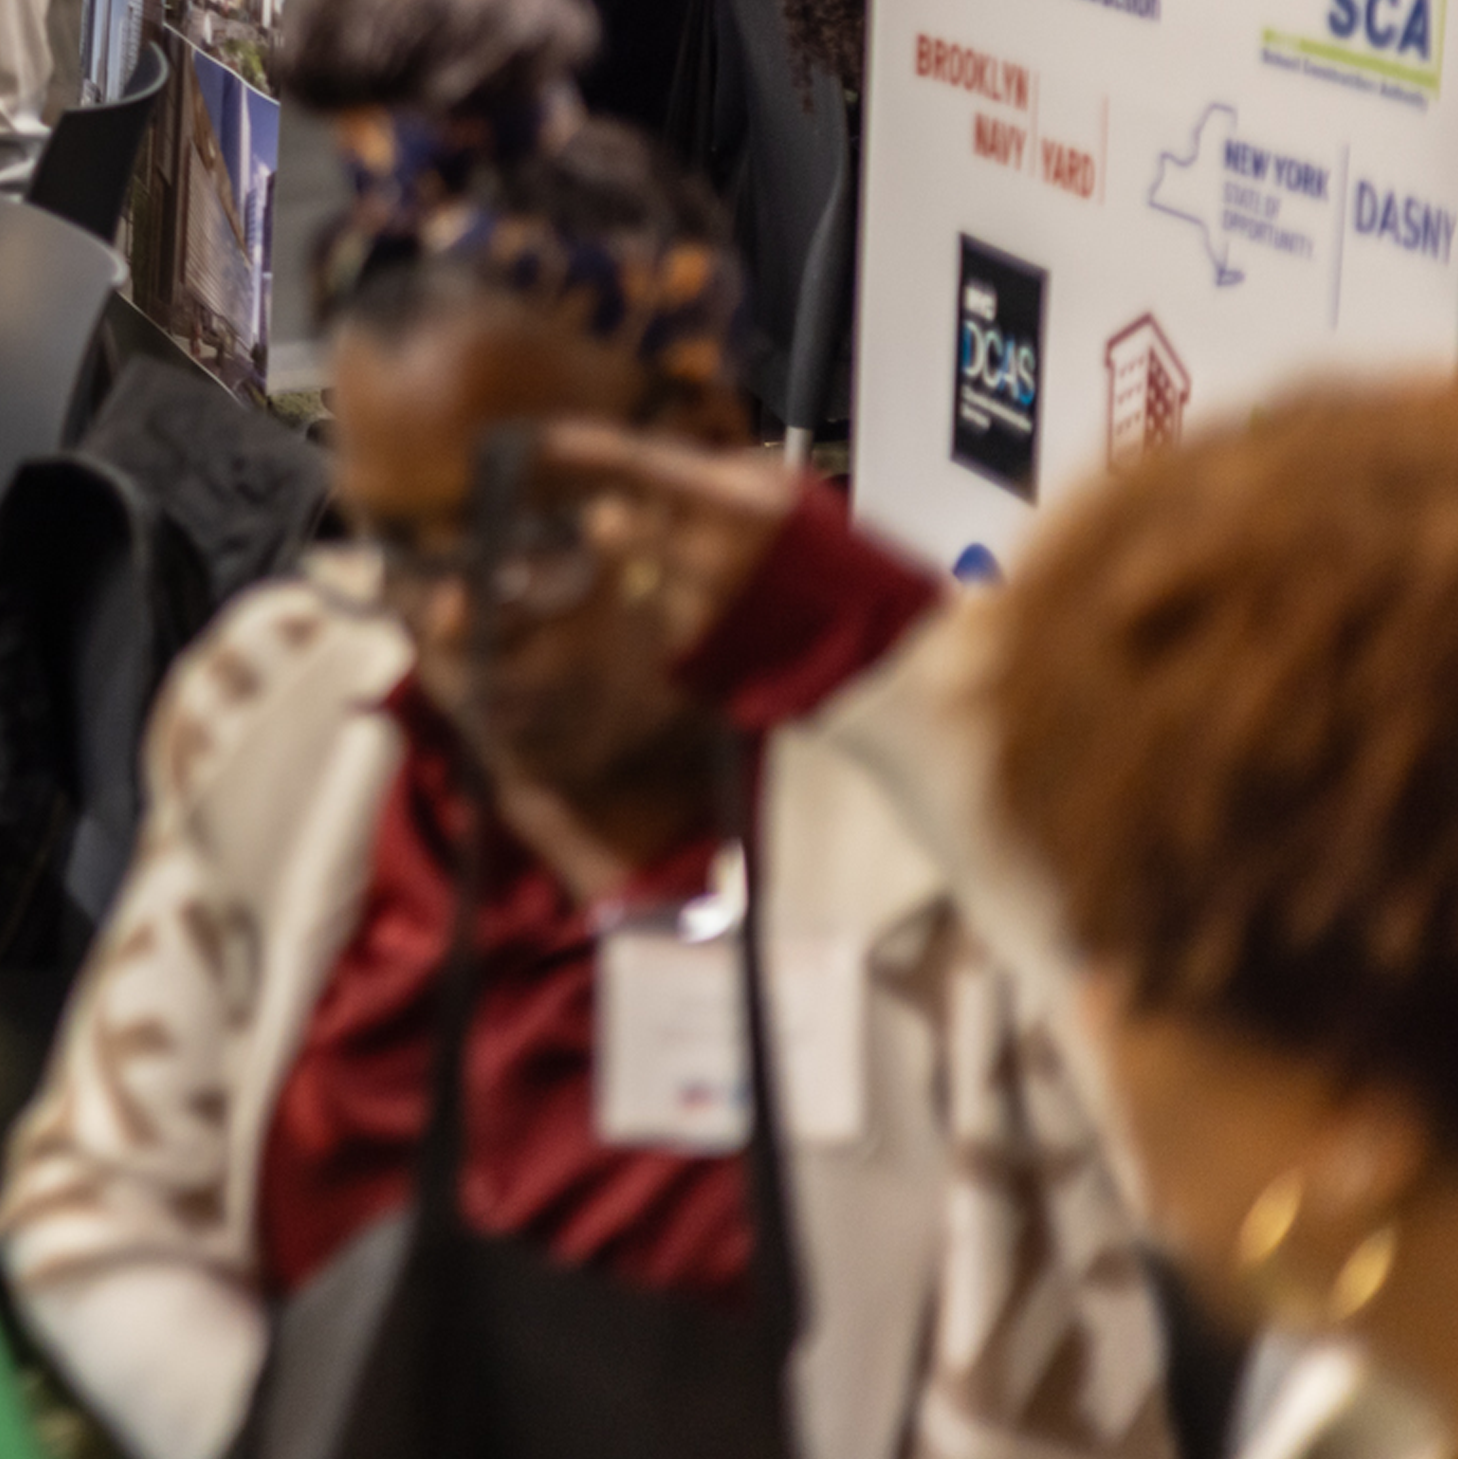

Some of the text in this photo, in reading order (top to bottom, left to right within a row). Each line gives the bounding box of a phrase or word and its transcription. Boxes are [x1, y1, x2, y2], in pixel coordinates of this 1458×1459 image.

[916, 32, 1028, 111] BROOKLYN
[973, 111, 1096, 200] NAVY YARD
[1224, 139, 1329, 202] NEW YORK
[1354, 178, 1457, 267] DASNY
[962, 318, 1035, 406] DCAS
